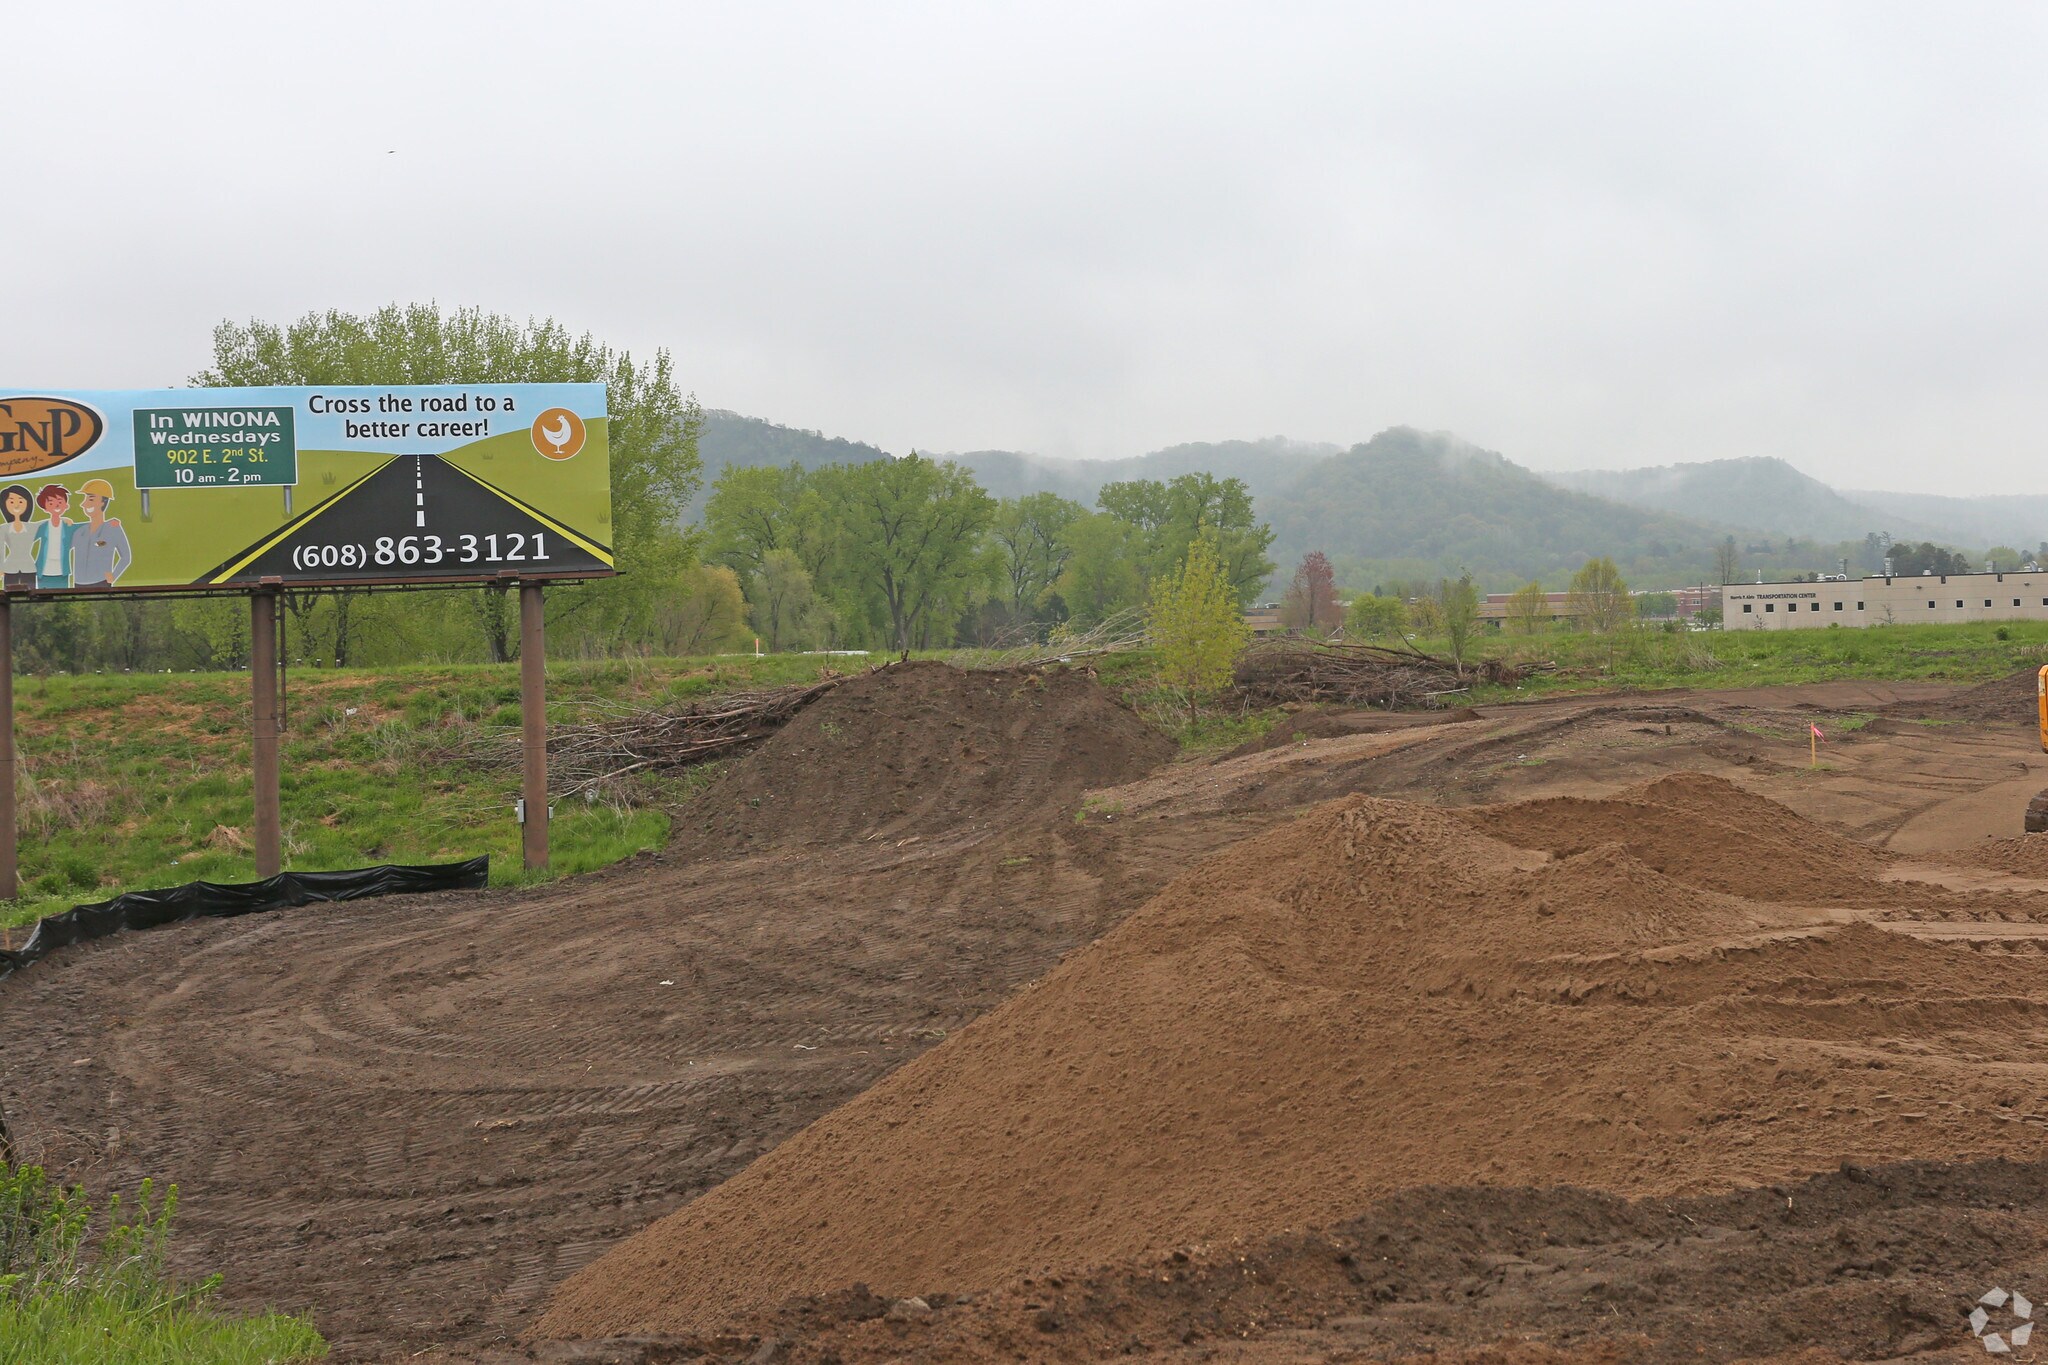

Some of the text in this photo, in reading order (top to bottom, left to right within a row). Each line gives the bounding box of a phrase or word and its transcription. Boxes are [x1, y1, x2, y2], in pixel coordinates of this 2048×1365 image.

[308, 393, 515, 413] Cross the road to a
[150, 411, 280, 429] In WINONA
[345, 419, 489, 438] better career!
[150, 431, 280, 446] Wednesdays
[167, 448, 268, 465] 902 E. 2nd St.
[174, 468, 194, 484] 10
[198, 474, 216, 483] am
[228, 468, 240, 482] 2
[243, 472, 261, 484] pm
[292, 532, 550, 570] (608) 863-3121
